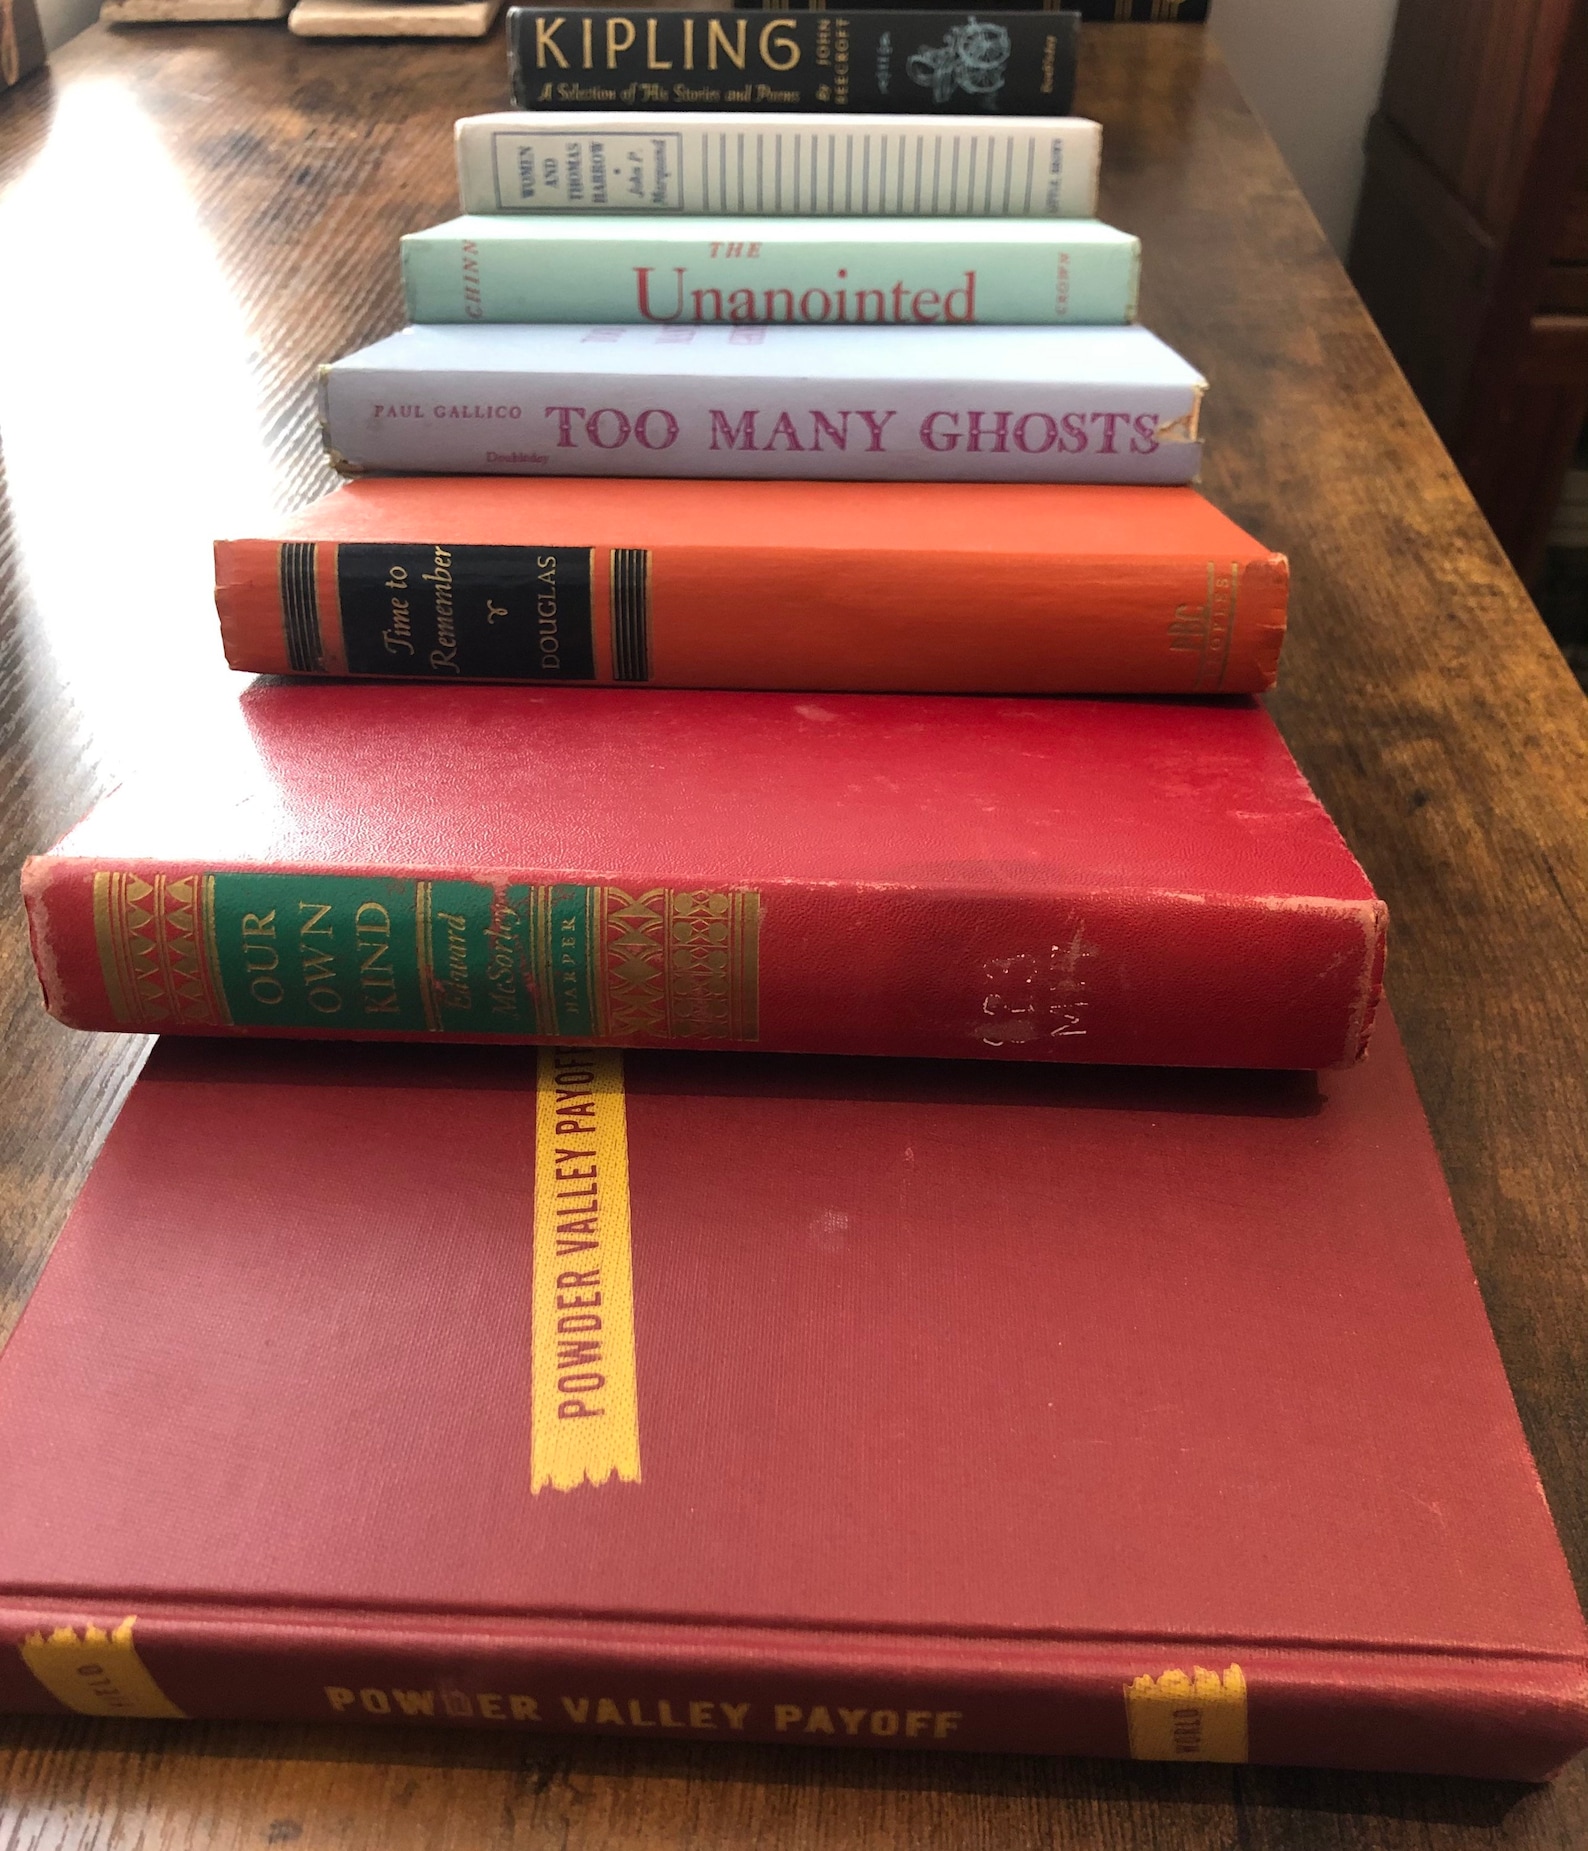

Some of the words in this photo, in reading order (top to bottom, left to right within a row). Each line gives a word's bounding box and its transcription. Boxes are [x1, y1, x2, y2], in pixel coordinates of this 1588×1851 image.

[535, 17, 801, 71] KIPLING
[816, 18, 831, 66] JOHN
[834, 18, 850, 104] BEECROFT
[620, 82, 638, 106] of
[672, 82, 721, 101] Stories
[724, 84, 751, 102] and
[754, 83, 800, 102] Poems
[518, 146, 535, 198] WOMEN
[543, 157, 559, 188] AND
[566, 141, 583, 200] THOMAS
[589, 140, 607, 203] HARROW
[462, 239, 484, 320] CHINN
[709, 242, 763, 259] THE
[632, 267, 977, 323] Unanointed
[1055, 252, 1069, 316] CROWN
[374, 404, 424, 419] PAUL
[433, 404, 522, 420] GALLICO
[545, 406, 680, 450] TOO
[708, 409, 897, 452] MANY
[919, 411, 1161, 455] GHOSTS
[486, 451, 549, 465] Doubleday
[385, 564, 409, 590] to
[384, 597, 415, 656] Time
[422, 545, 460, 674] Remember
[537, 555, 560, 670] DOUGLAS
[242, 909, 285, 1005] OUR
[299, 900, 344, 1014] OWN
[355, 901, 400, 1014] KIND
[437, 911, 472, 1010] Edward
[562, 915, 579, 1014] HARPER
[555, 1149, 599, 1256] VALLEY
[556, 1269, 606, 1420] POWDER
[324, 1686, 542, 1721] POWDER
[561, 1696, 751, 1729] VALLEY
[774, 1704, 963, 1738] PAYOFF
